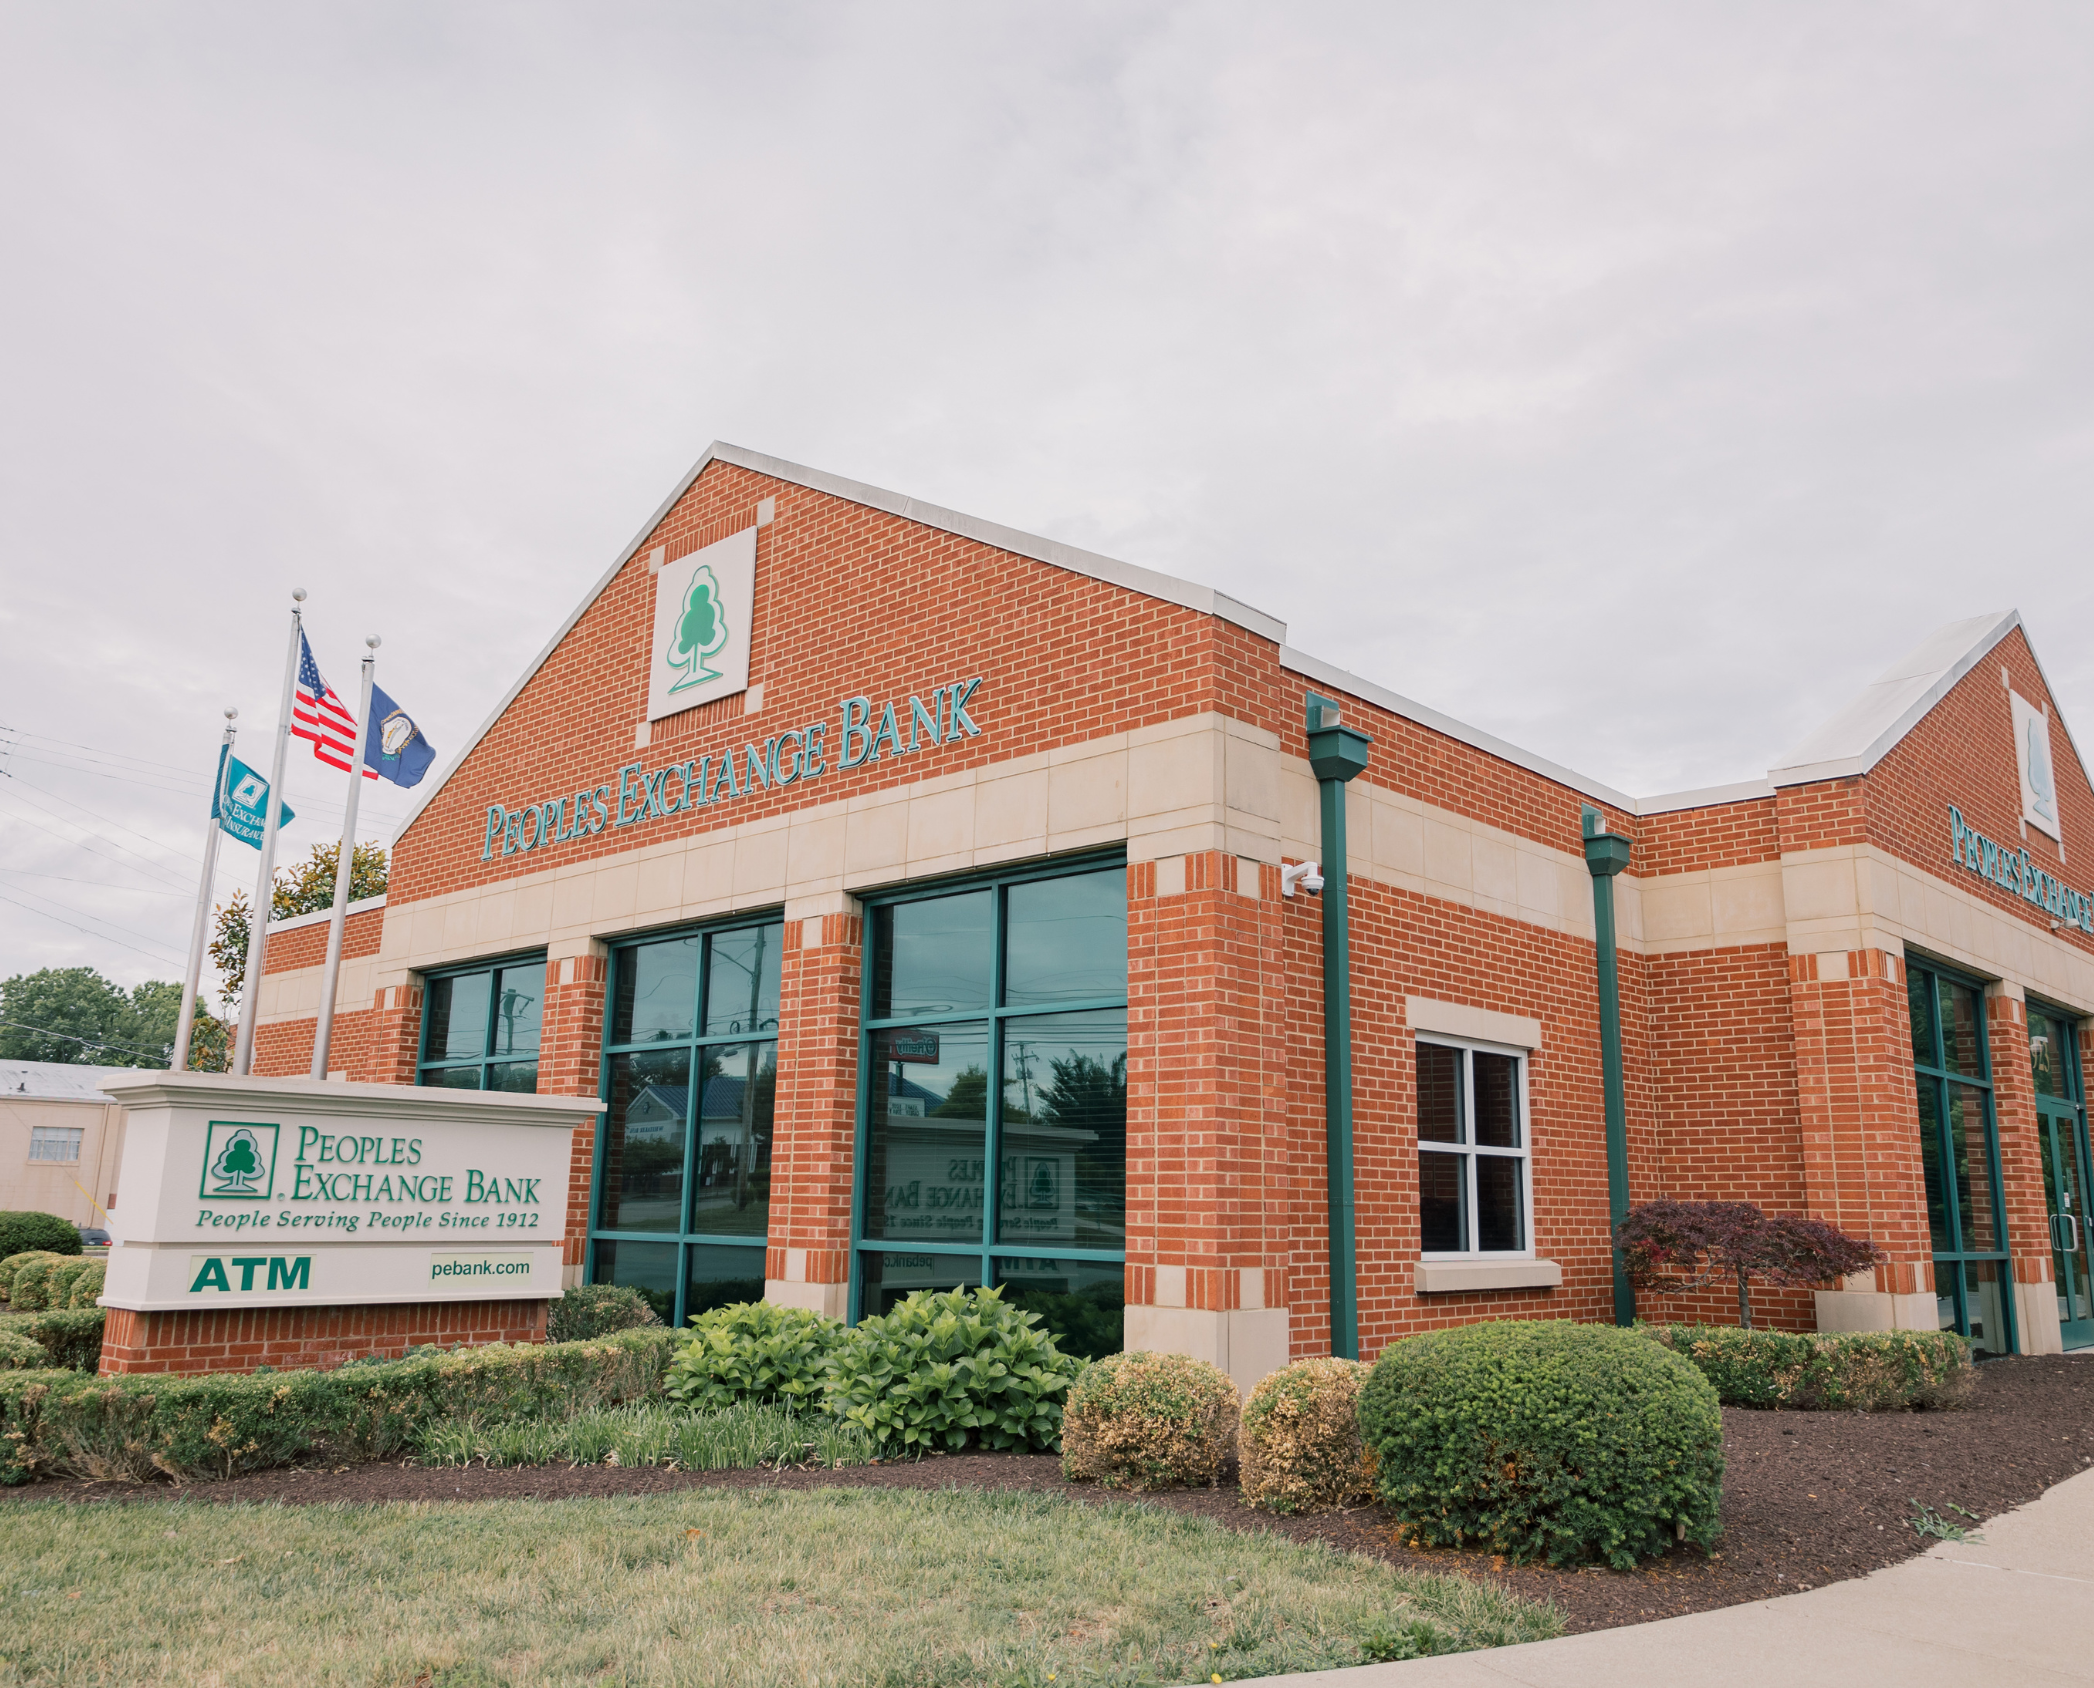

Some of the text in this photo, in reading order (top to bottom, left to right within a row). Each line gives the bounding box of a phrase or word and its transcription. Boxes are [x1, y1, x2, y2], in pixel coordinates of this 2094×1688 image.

[480, 675, 984, 862] PEOPLES EXCHANGE BANK
[1947, 803, 2021, 896] PEOPLES
[295, 1125, 423, 1166] PEOPLES
[290, 1164, 542, 1204] EXCHANGE BANK
[195, 1209, 540, 1232] People Serving People Since 1912
[188, 1256, 531, 1293] ATM pebank.com
